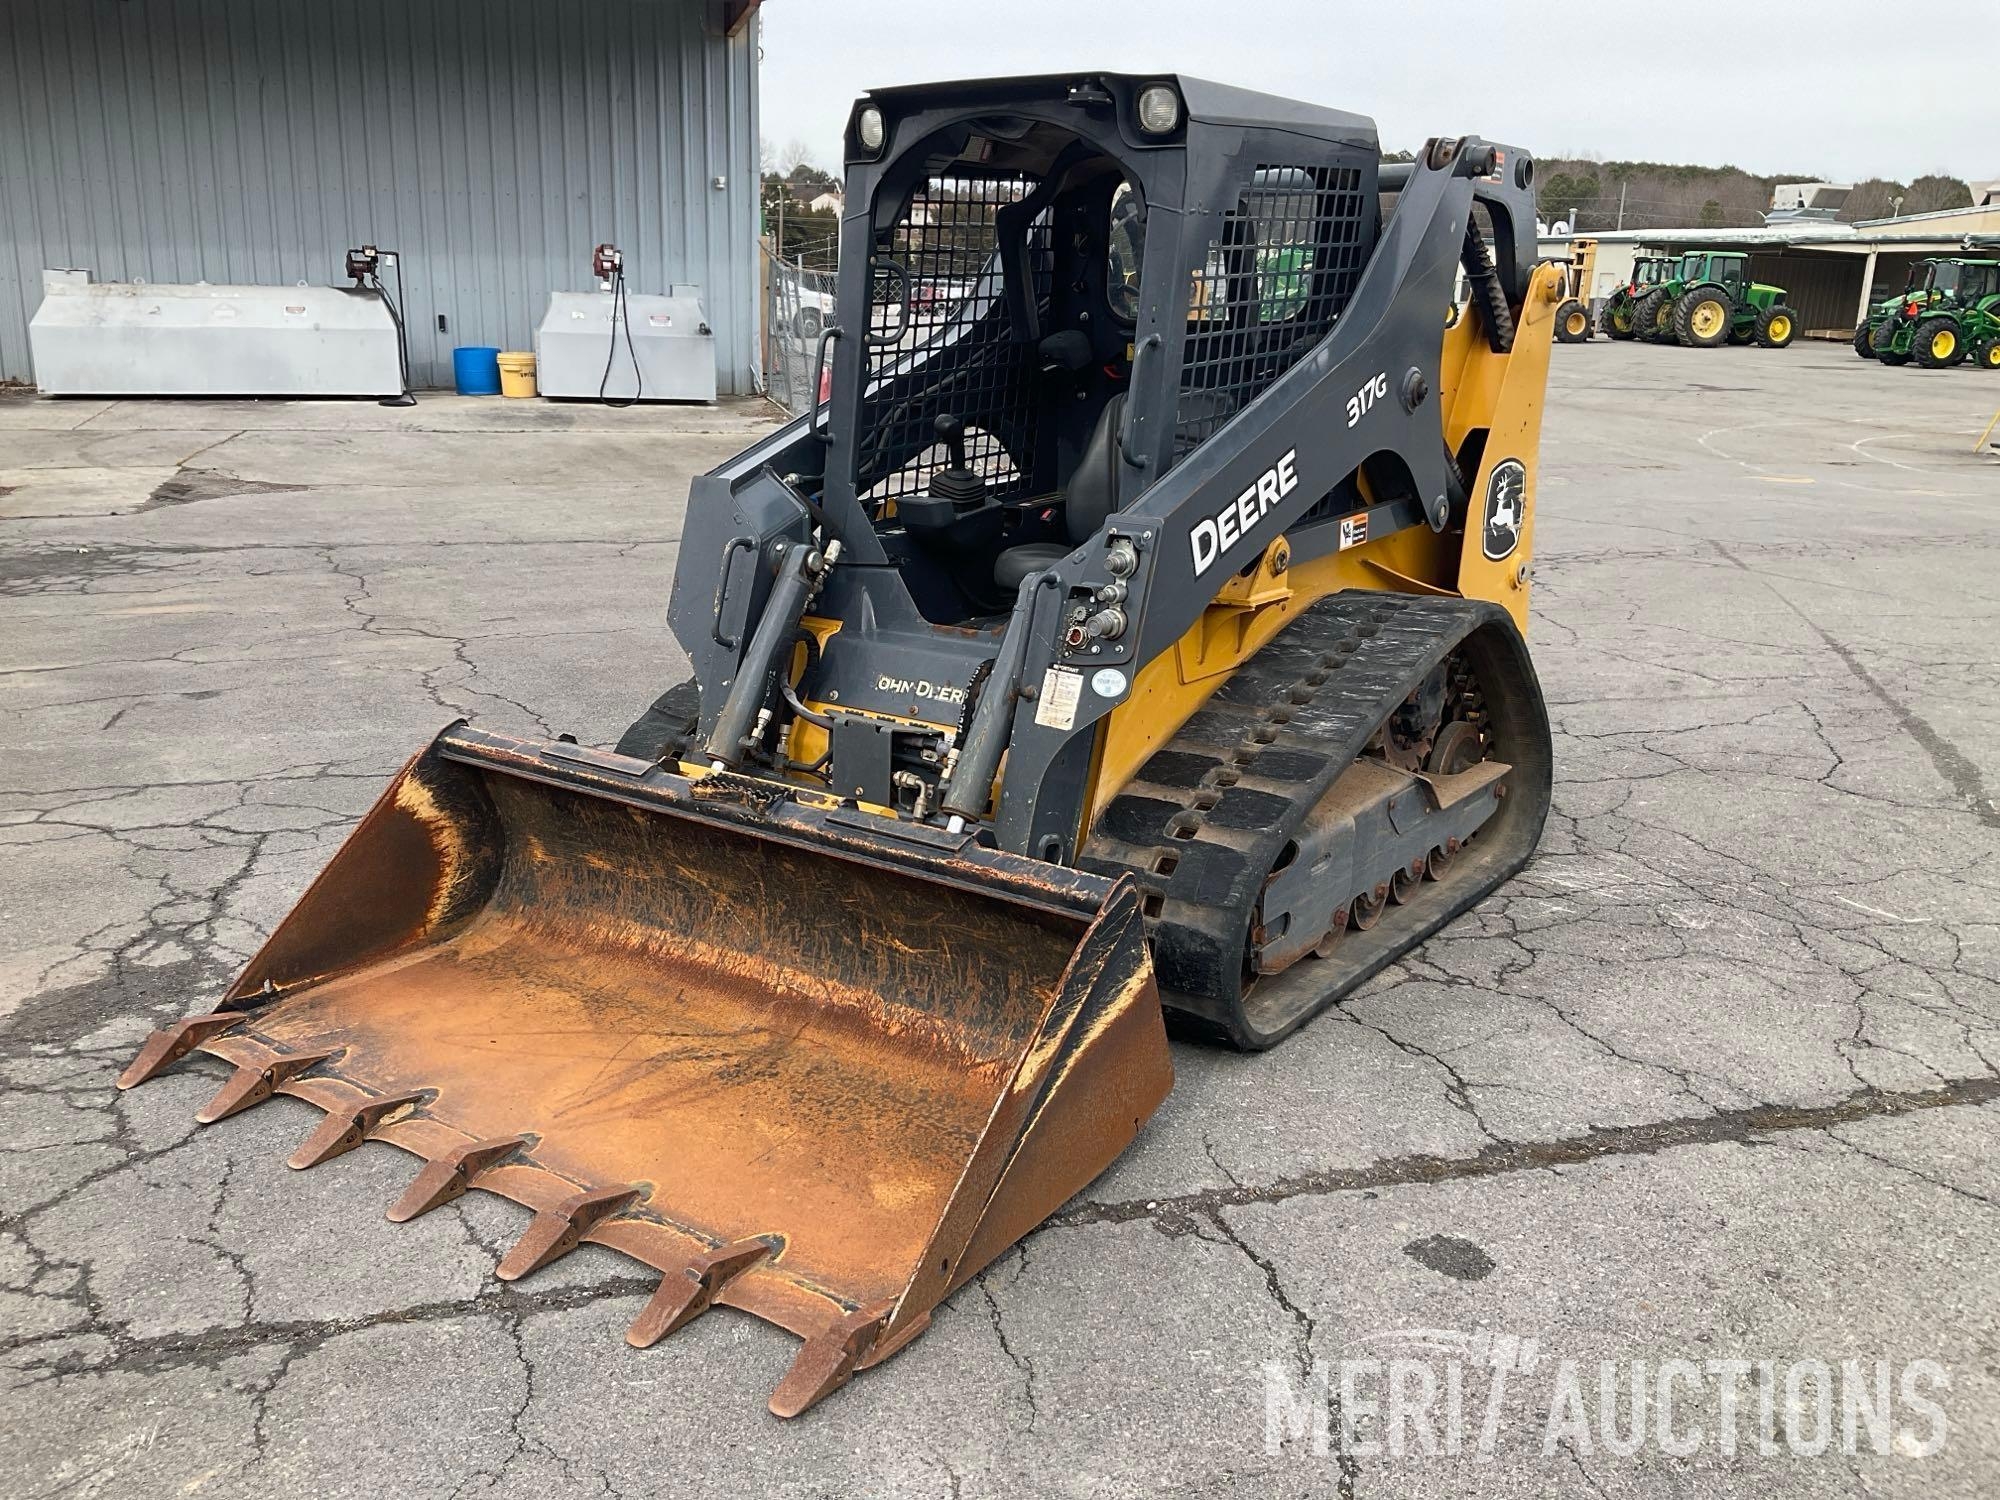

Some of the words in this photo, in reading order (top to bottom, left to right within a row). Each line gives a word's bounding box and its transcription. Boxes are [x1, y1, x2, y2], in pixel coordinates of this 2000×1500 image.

[1346, 372, 1387, 428] 317G
[1190, 449, 1298, 577] DEERE
[874, 677, 915, 693] OHN
